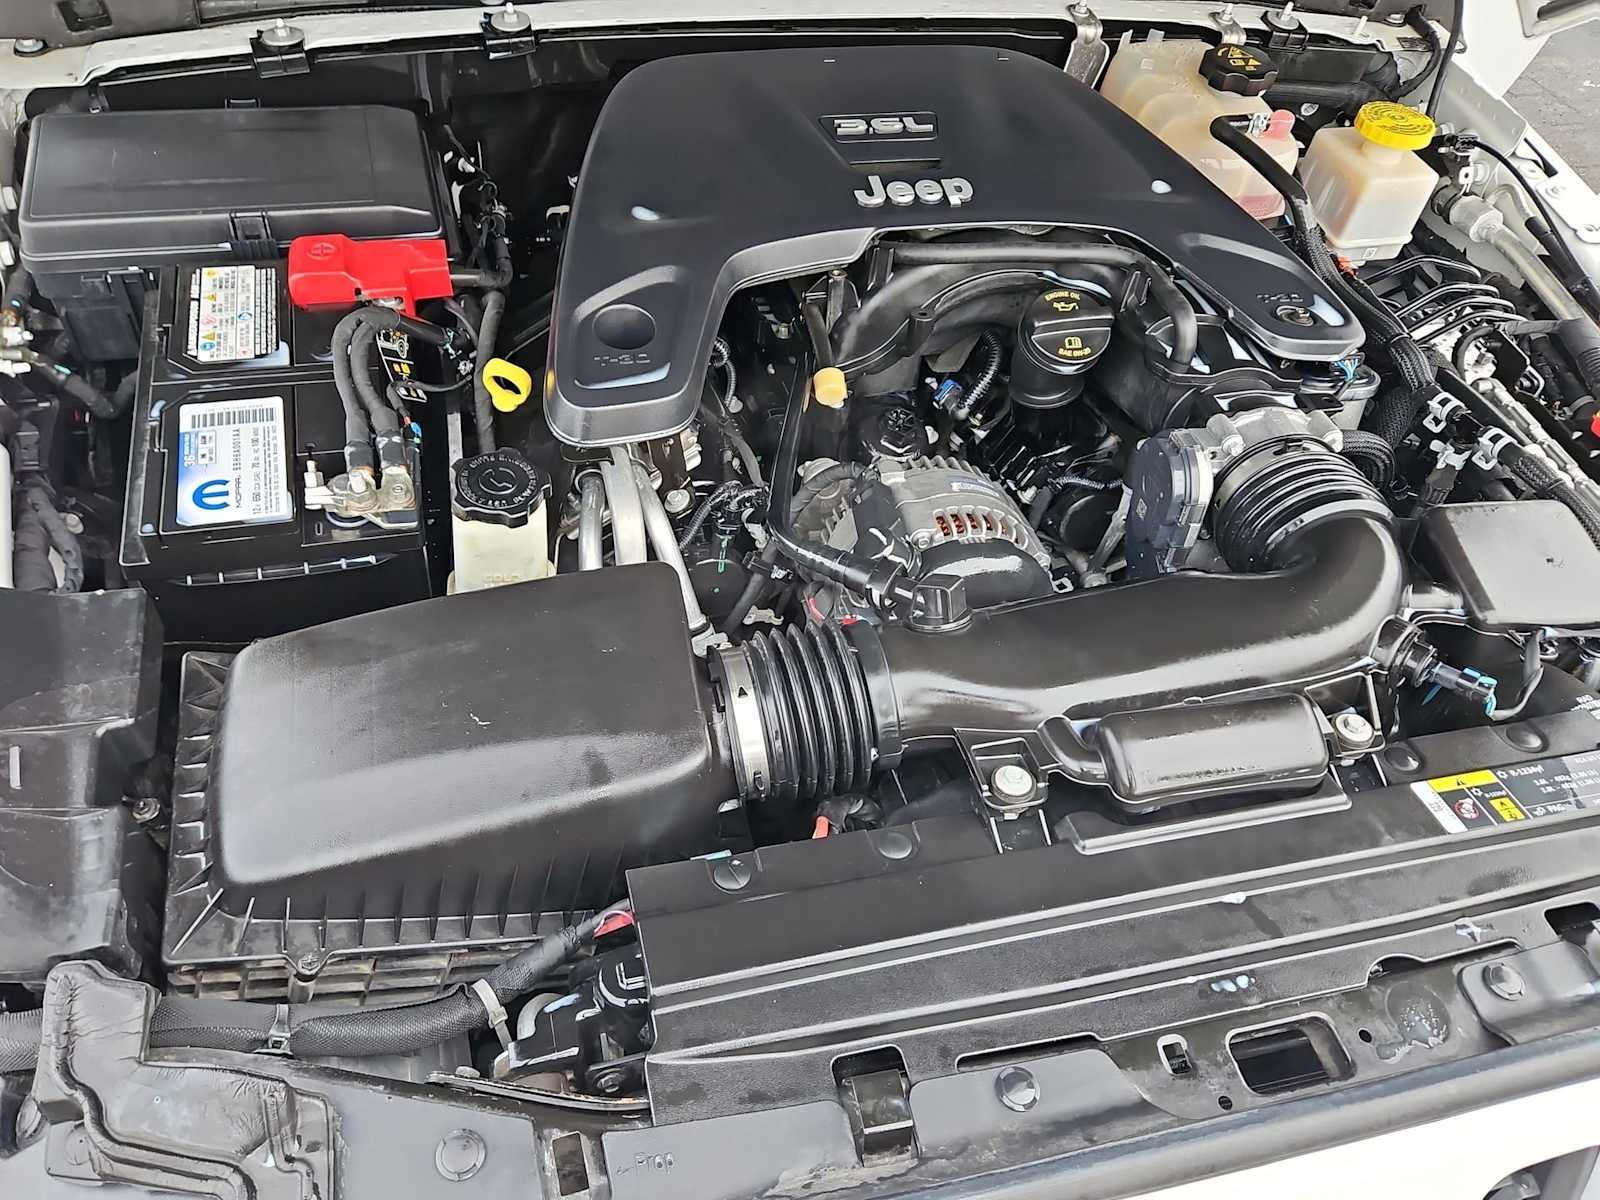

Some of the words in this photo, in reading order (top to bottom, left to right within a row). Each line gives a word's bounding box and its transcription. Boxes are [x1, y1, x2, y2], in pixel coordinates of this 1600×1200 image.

[854, 175, 974, 208] Jeep
[1044, 291, 1069, 301] ENGINE
[1070, 292, 1081, 300] OIL
[1058, 347, 1072, 357] SAE
[635, 1152, 674, 1176] Prop
